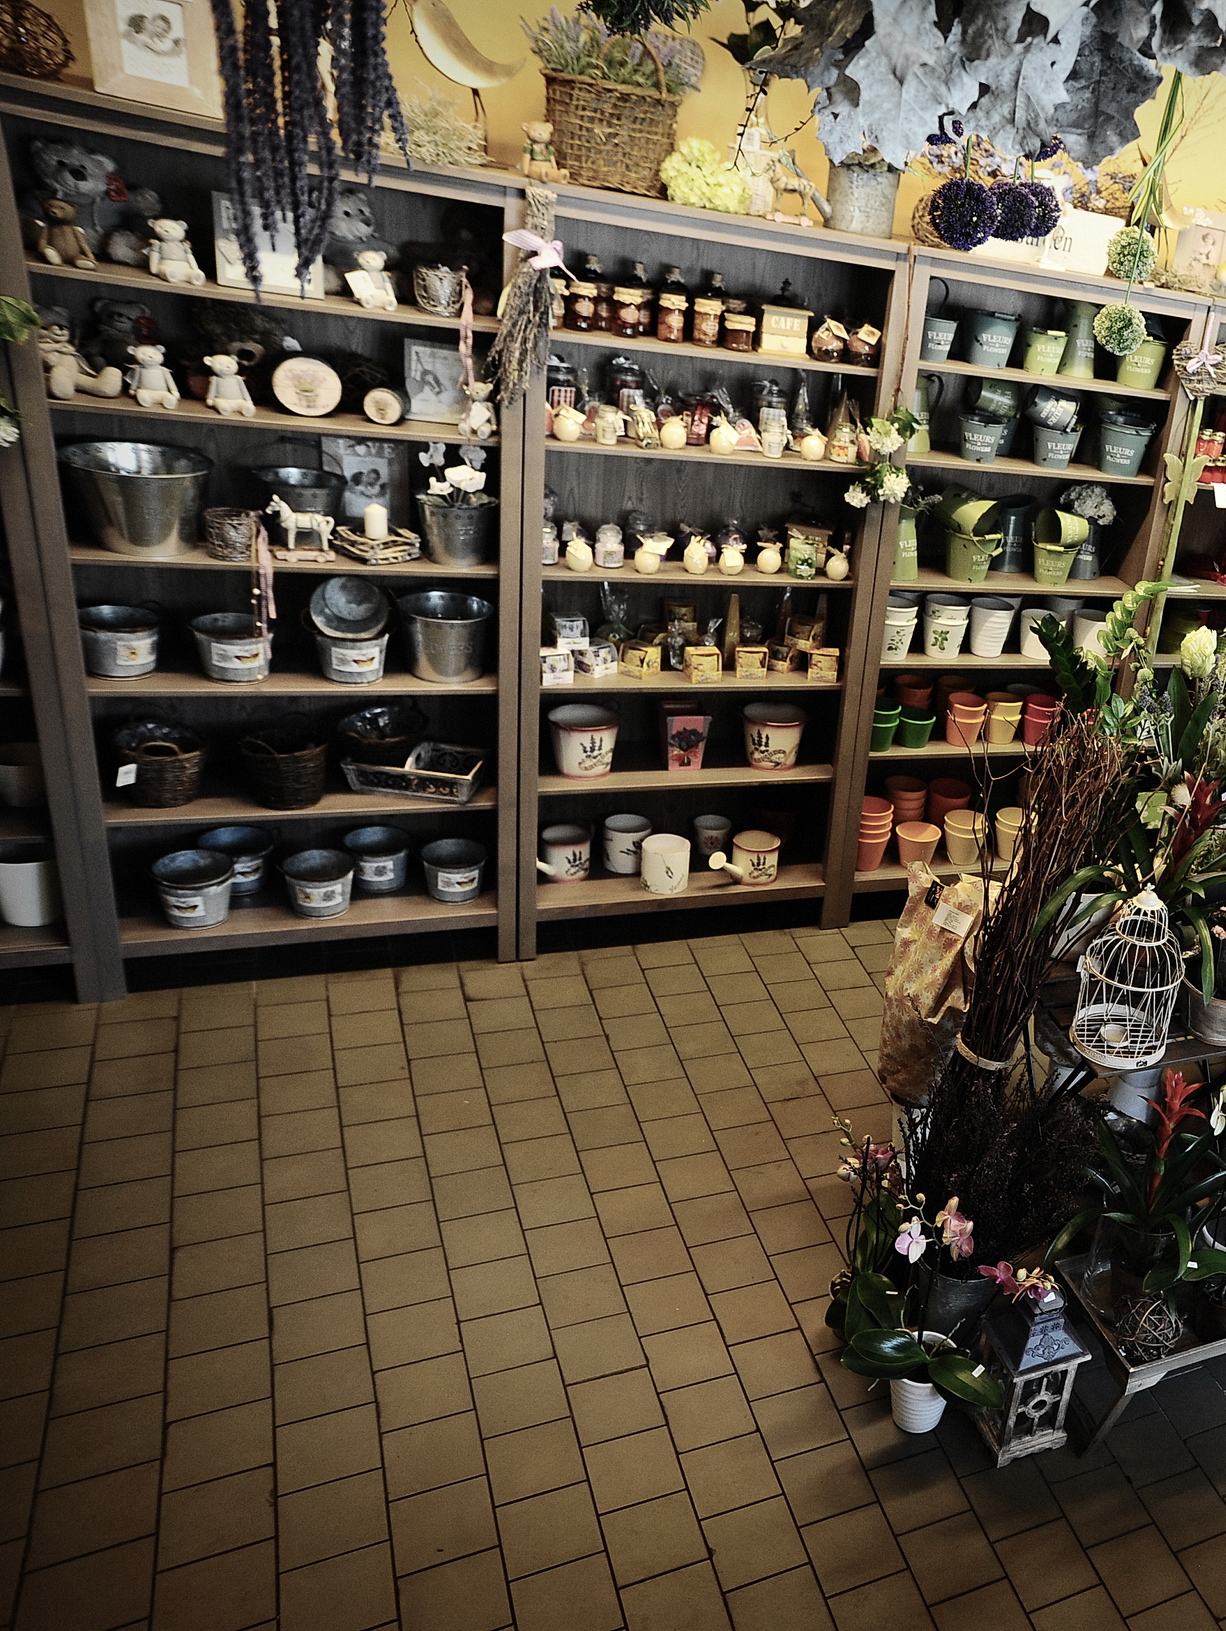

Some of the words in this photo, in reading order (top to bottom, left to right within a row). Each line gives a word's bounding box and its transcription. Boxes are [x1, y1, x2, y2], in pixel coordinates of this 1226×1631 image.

[770, 315, 801, 331] CAFE
[964, 432, 996, 444] FLEURS
[1105, 444, 1135, 457] FLEURS
